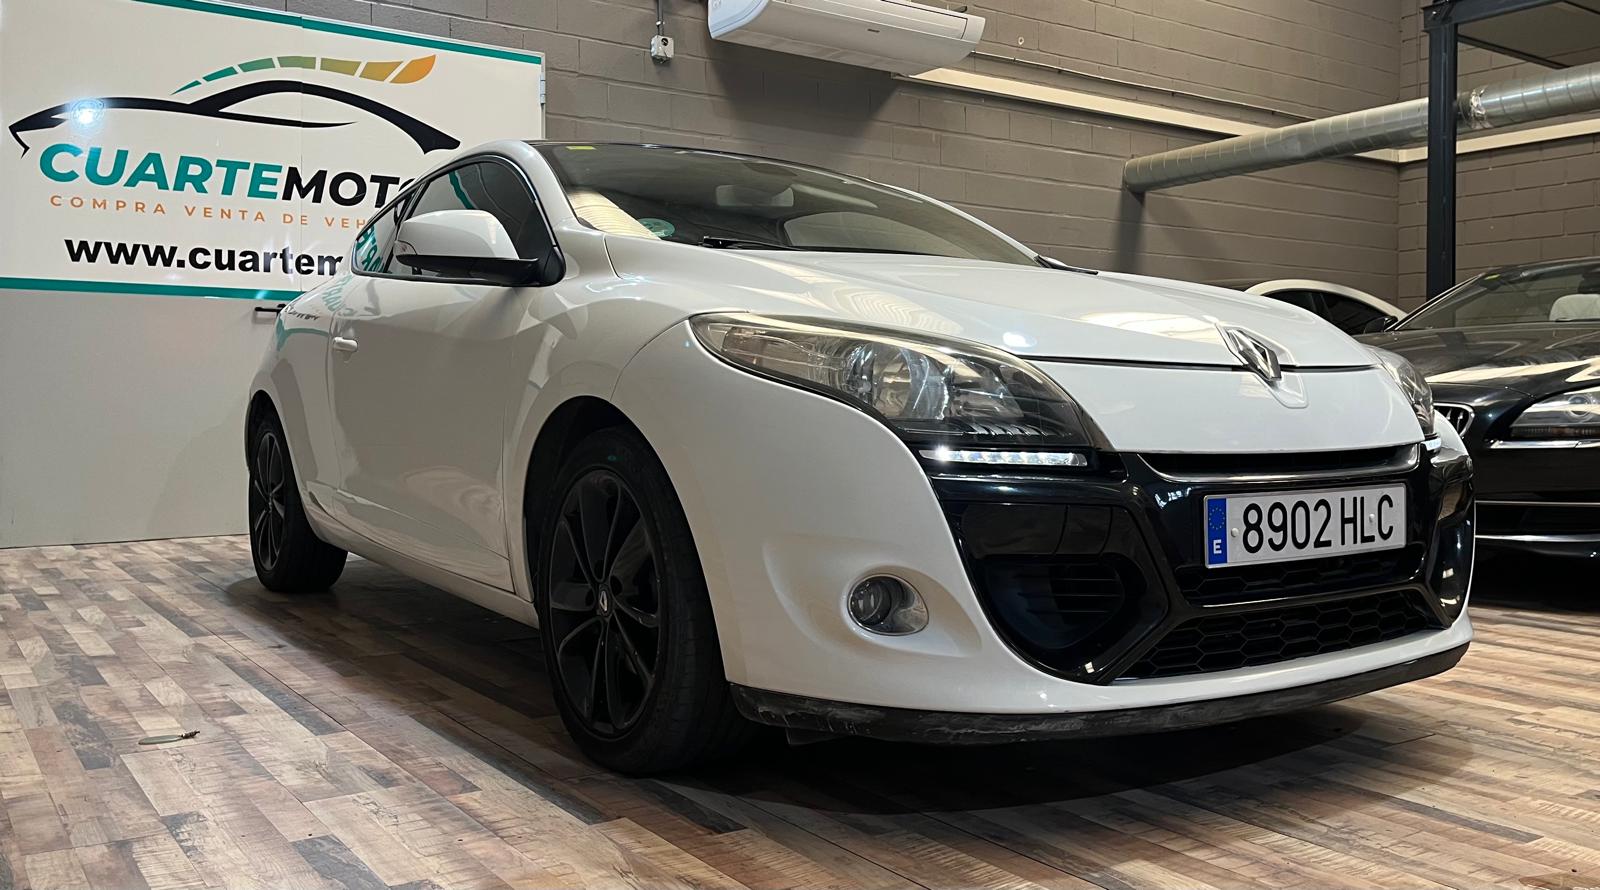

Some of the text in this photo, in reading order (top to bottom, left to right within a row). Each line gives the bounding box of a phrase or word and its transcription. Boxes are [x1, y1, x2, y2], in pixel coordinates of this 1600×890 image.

[40, 143, 416, 208] CUARTEMOT
[50, 195, 166, 214] COMPRA
[184, 205, 265, 222] VENTA
[283, 213, 308, 225] DE
[1242, 494, 1394, 553] 8902 HLC
[1213, 539, 1222, 554] E
